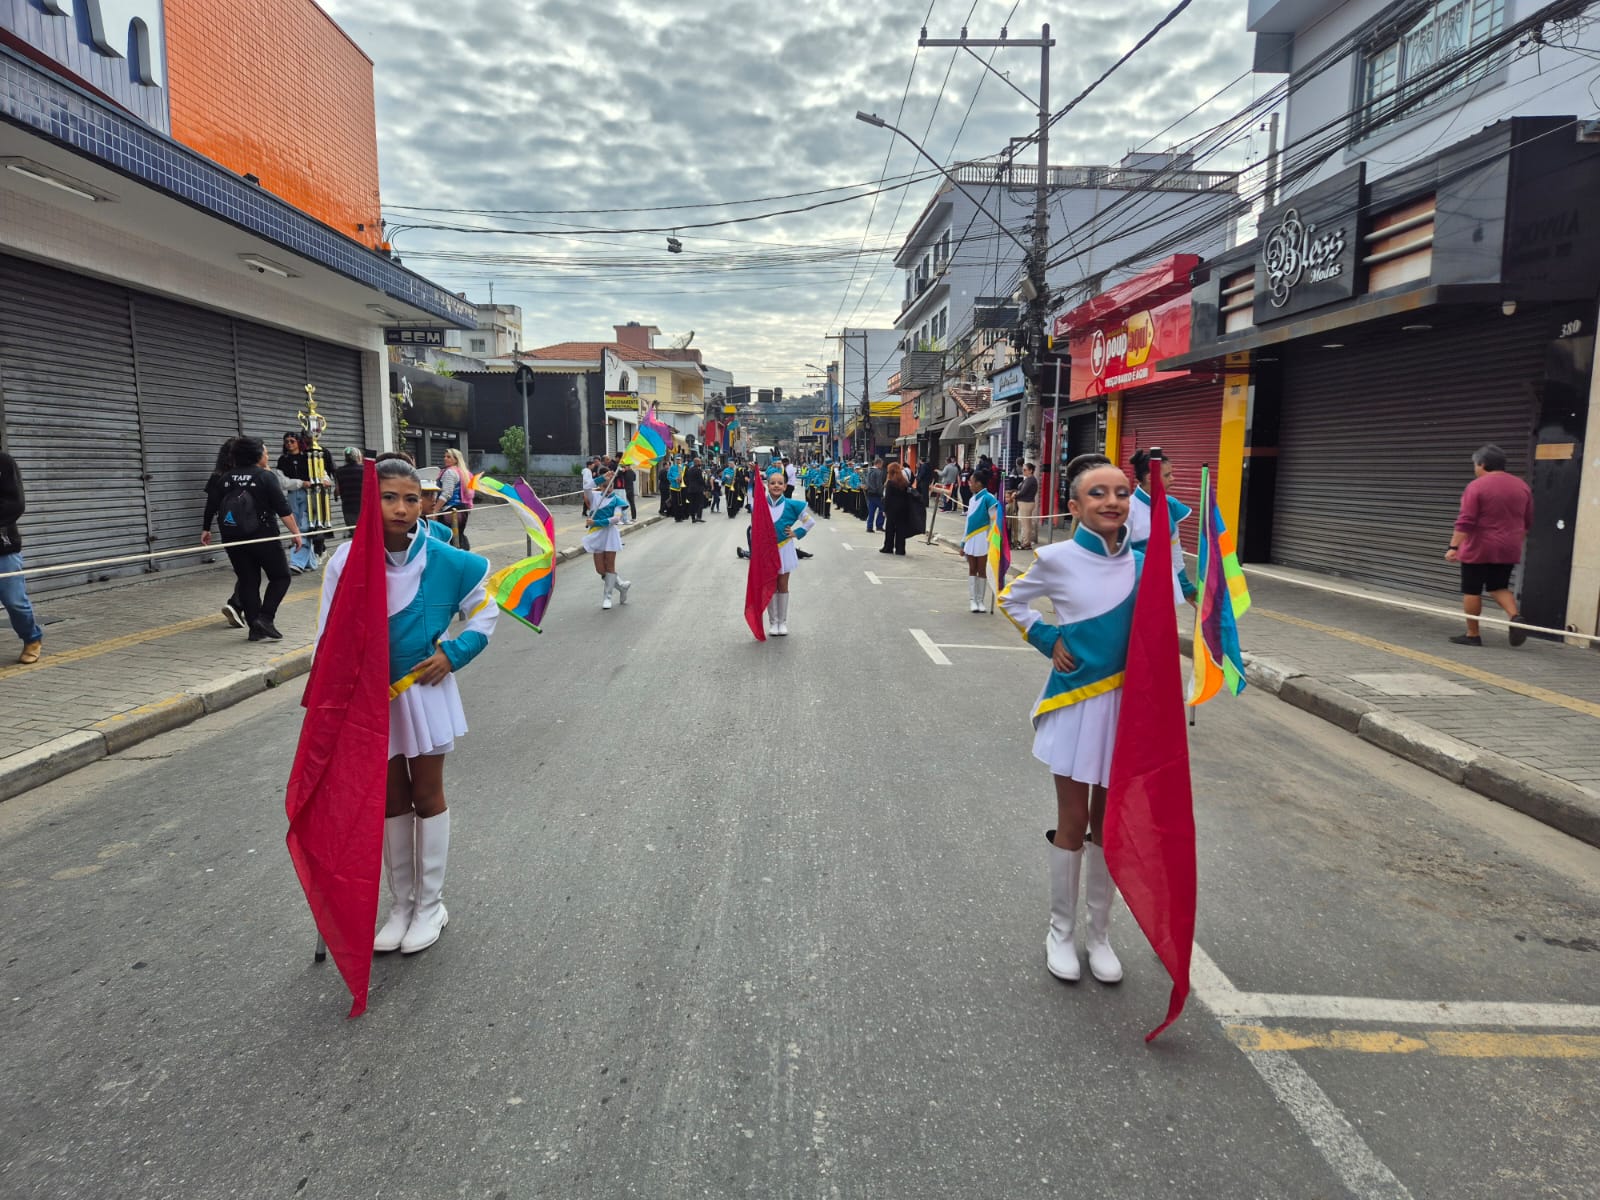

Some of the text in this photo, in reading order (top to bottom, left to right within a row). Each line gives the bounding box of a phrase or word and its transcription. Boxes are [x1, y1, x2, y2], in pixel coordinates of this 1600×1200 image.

[1263, 208, 1345, 307] Bless
[1310, 263, 1341, 284] Modas
[1559, 319, 1582, 338] 380
